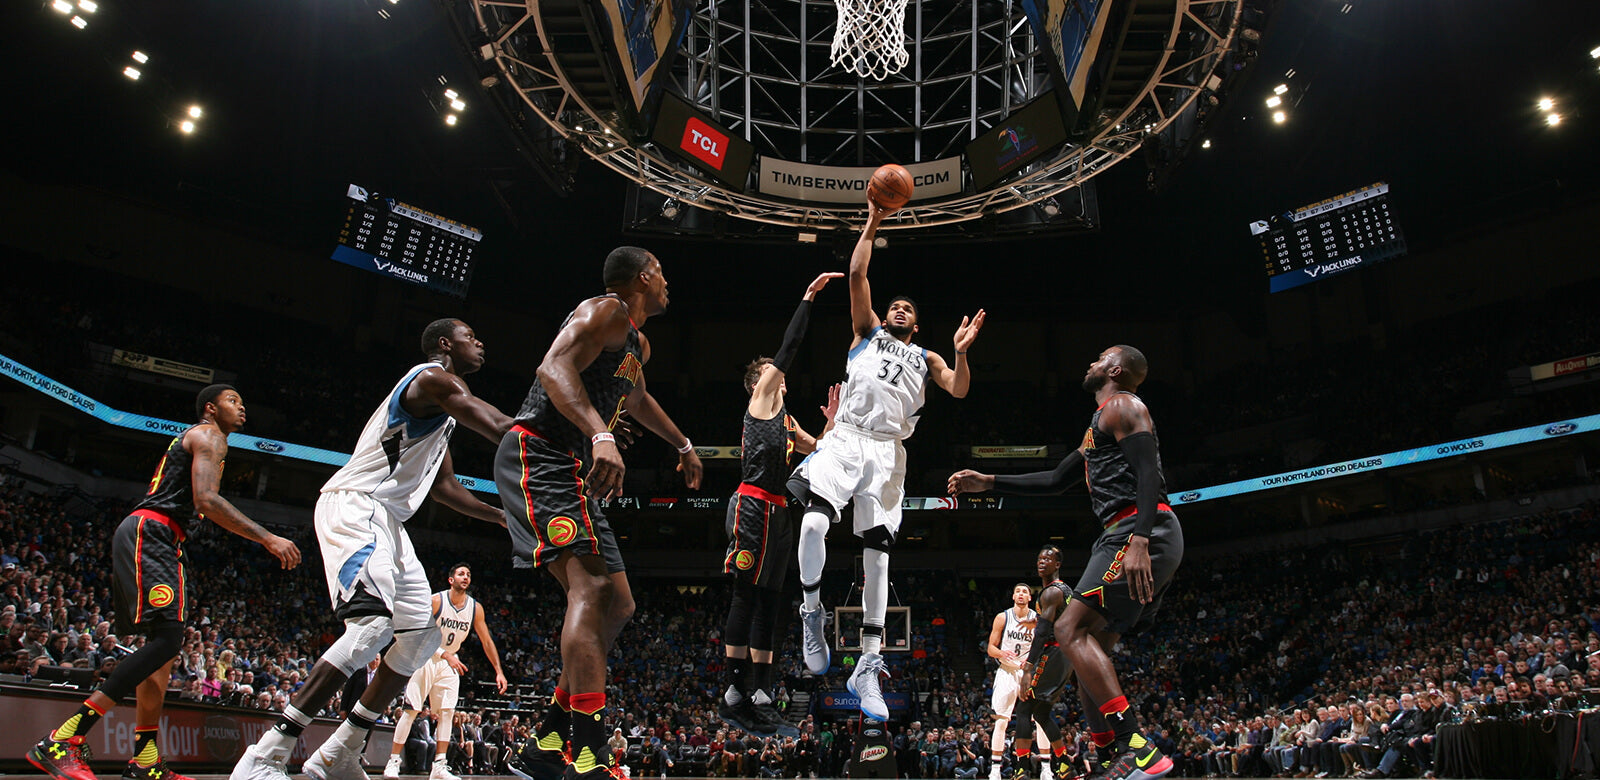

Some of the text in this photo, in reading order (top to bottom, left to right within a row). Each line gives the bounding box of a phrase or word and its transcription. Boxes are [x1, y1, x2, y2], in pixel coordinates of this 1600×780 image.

[691, 128, 720, 158] TCL
[872, 338, 922, 369] WOLVES
[878, 359, 903, 385] 32
[13, 366, 51, 390] NORTHLAND
[52, 384, 68, 398] FORD
[68, 393, 95, 411] DEALERS
[146, 420, 159, 429] GO
[1437, 440, 1484, 455] GO WOLVES
[1262, 458, 1383, 486] YOUR NORTHLAND FORD DEALERS
[440, 617, 470, 632] WOLVES
[1007, 630, 1033, 642] WOLVES
[446, 633, 455, 646] 9
[158, 716, 200, 757] Your
